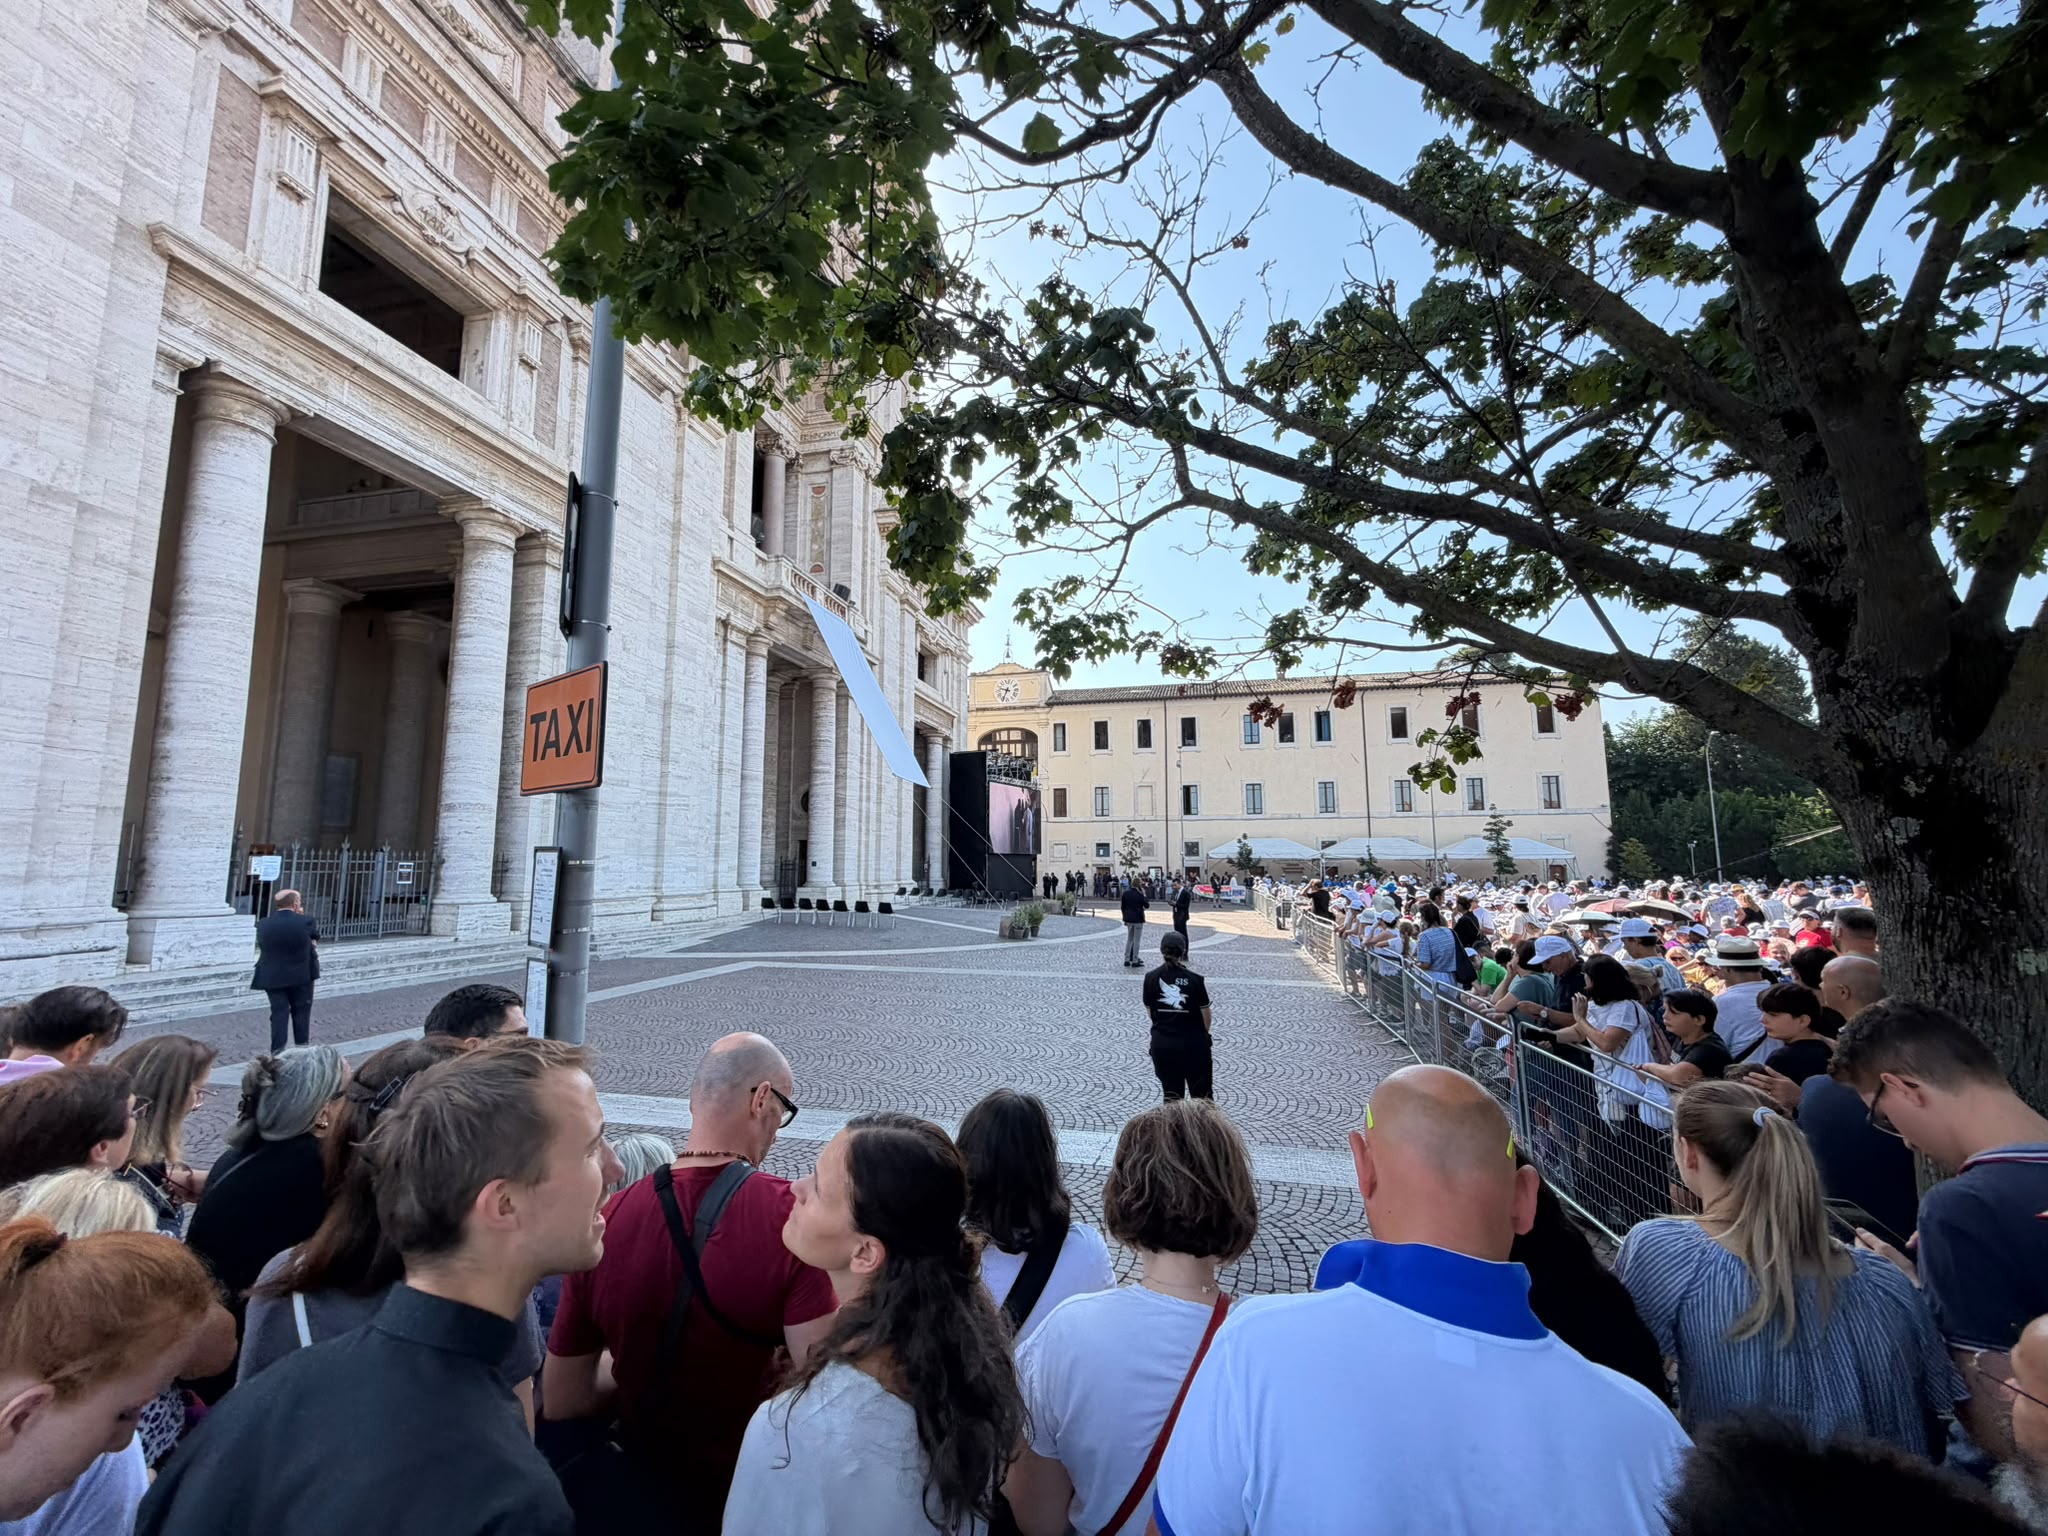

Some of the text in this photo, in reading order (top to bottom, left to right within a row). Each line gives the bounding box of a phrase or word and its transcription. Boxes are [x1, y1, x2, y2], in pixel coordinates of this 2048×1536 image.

[416, 206, 455, 241] MARIA
[530, 698, 594, 762] TAXI
[1175, 977, 1189, 986] SIS
